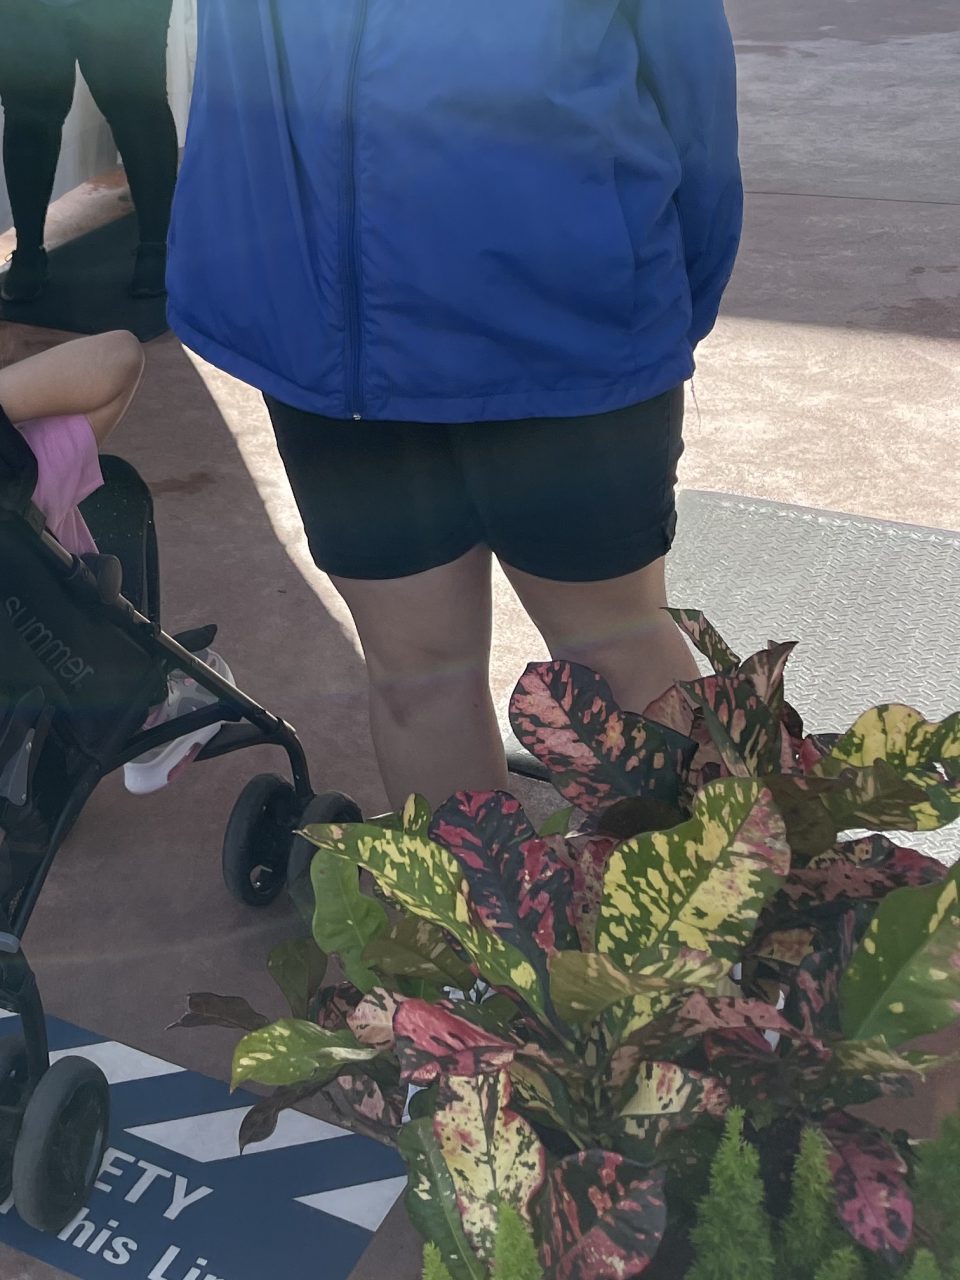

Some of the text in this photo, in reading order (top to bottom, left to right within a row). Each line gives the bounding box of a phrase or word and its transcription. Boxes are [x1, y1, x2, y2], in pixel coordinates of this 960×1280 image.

[5, 596, 95, 685] summer
[93, 1146, 215, 1221] ETY
[56, 1207, 138, 1266] his
[147, 1244, 225, 1280] Li
